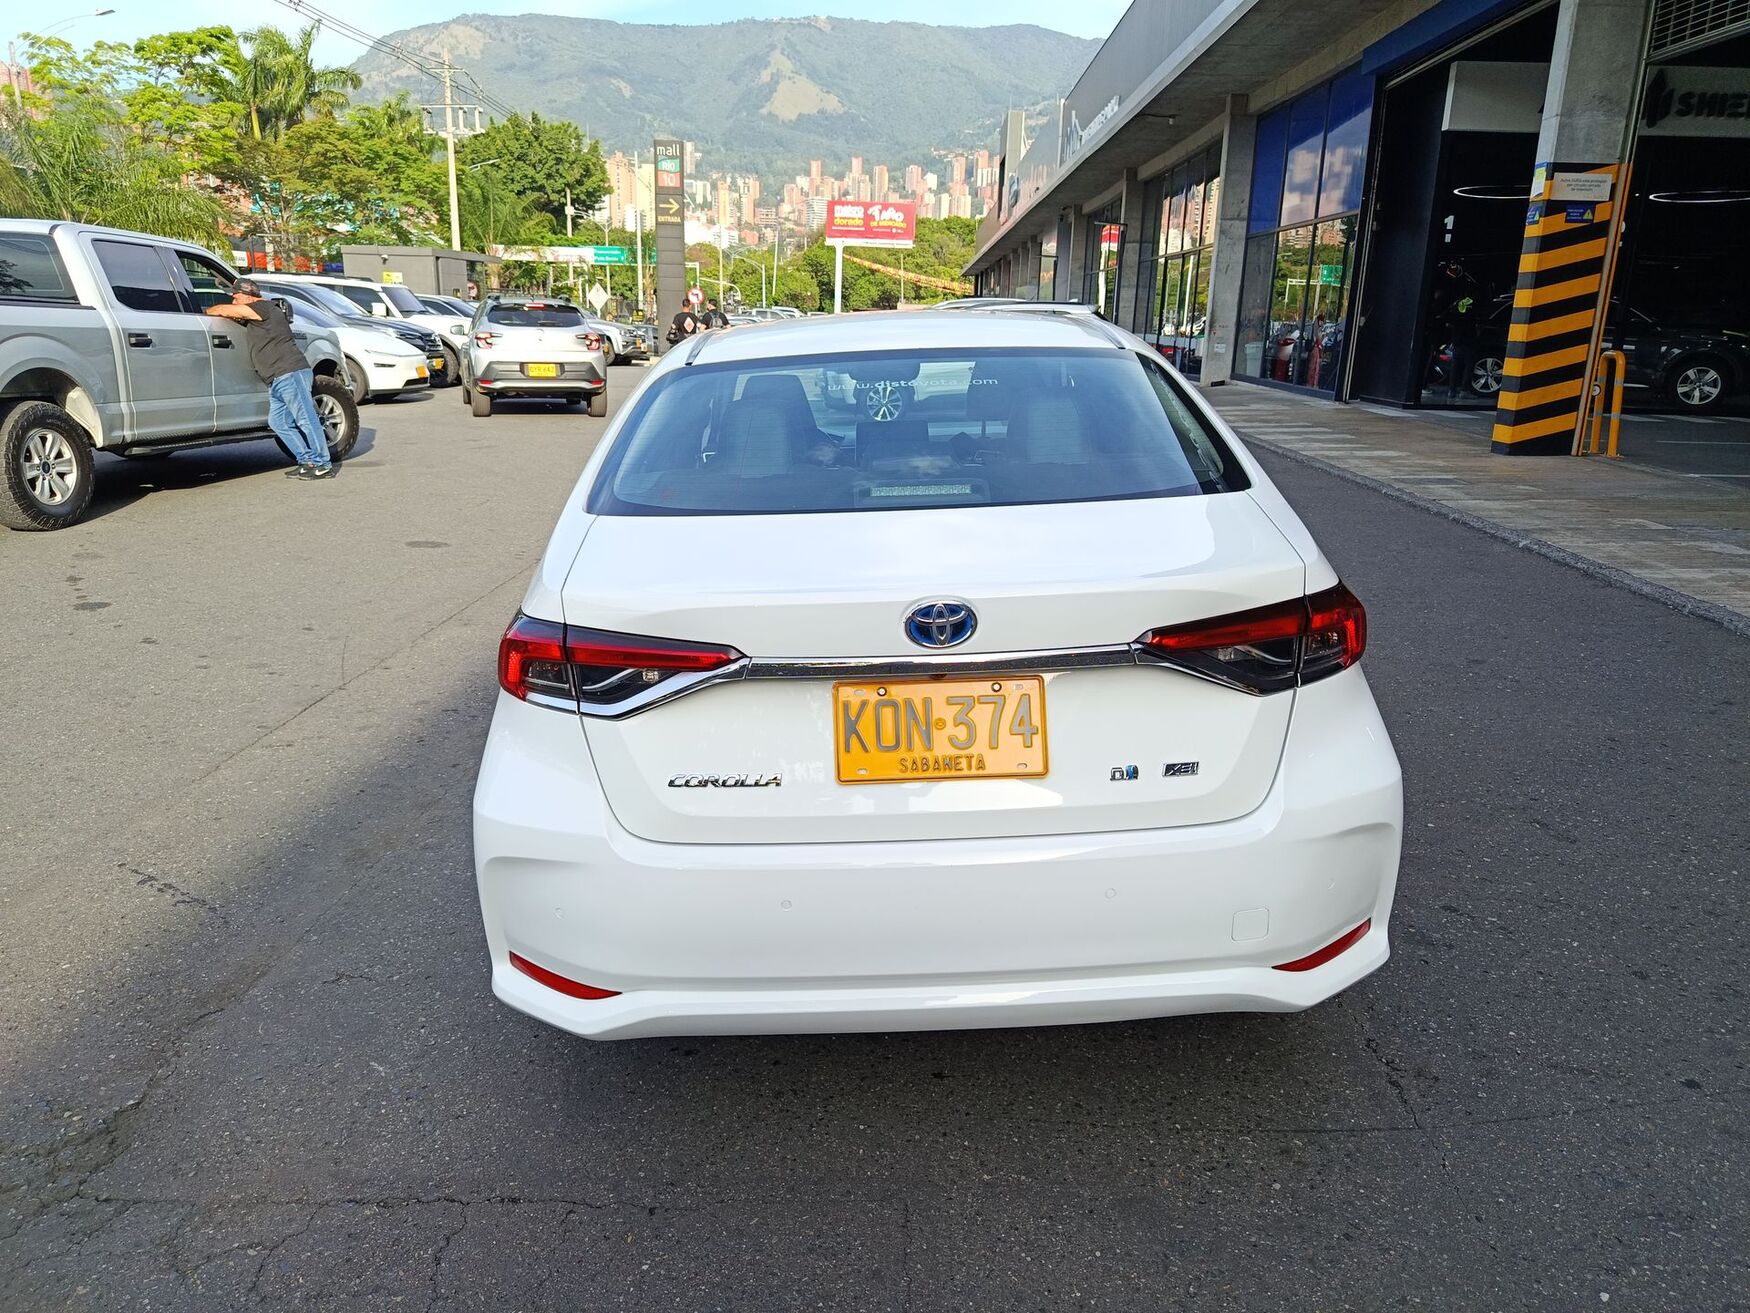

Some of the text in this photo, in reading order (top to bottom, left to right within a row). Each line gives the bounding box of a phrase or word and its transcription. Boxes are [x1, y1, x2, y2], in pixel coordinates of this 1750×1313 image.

[1675, 91, 1750, 117] SHIE
[656, 144, 680, 156] mall
[663, 173, 677, 186] 10
[842, 693, 1039, 753] KON 374
[897, 753, 987, 773] SABANETA
[668, 773, 783, 788] COROLLA
